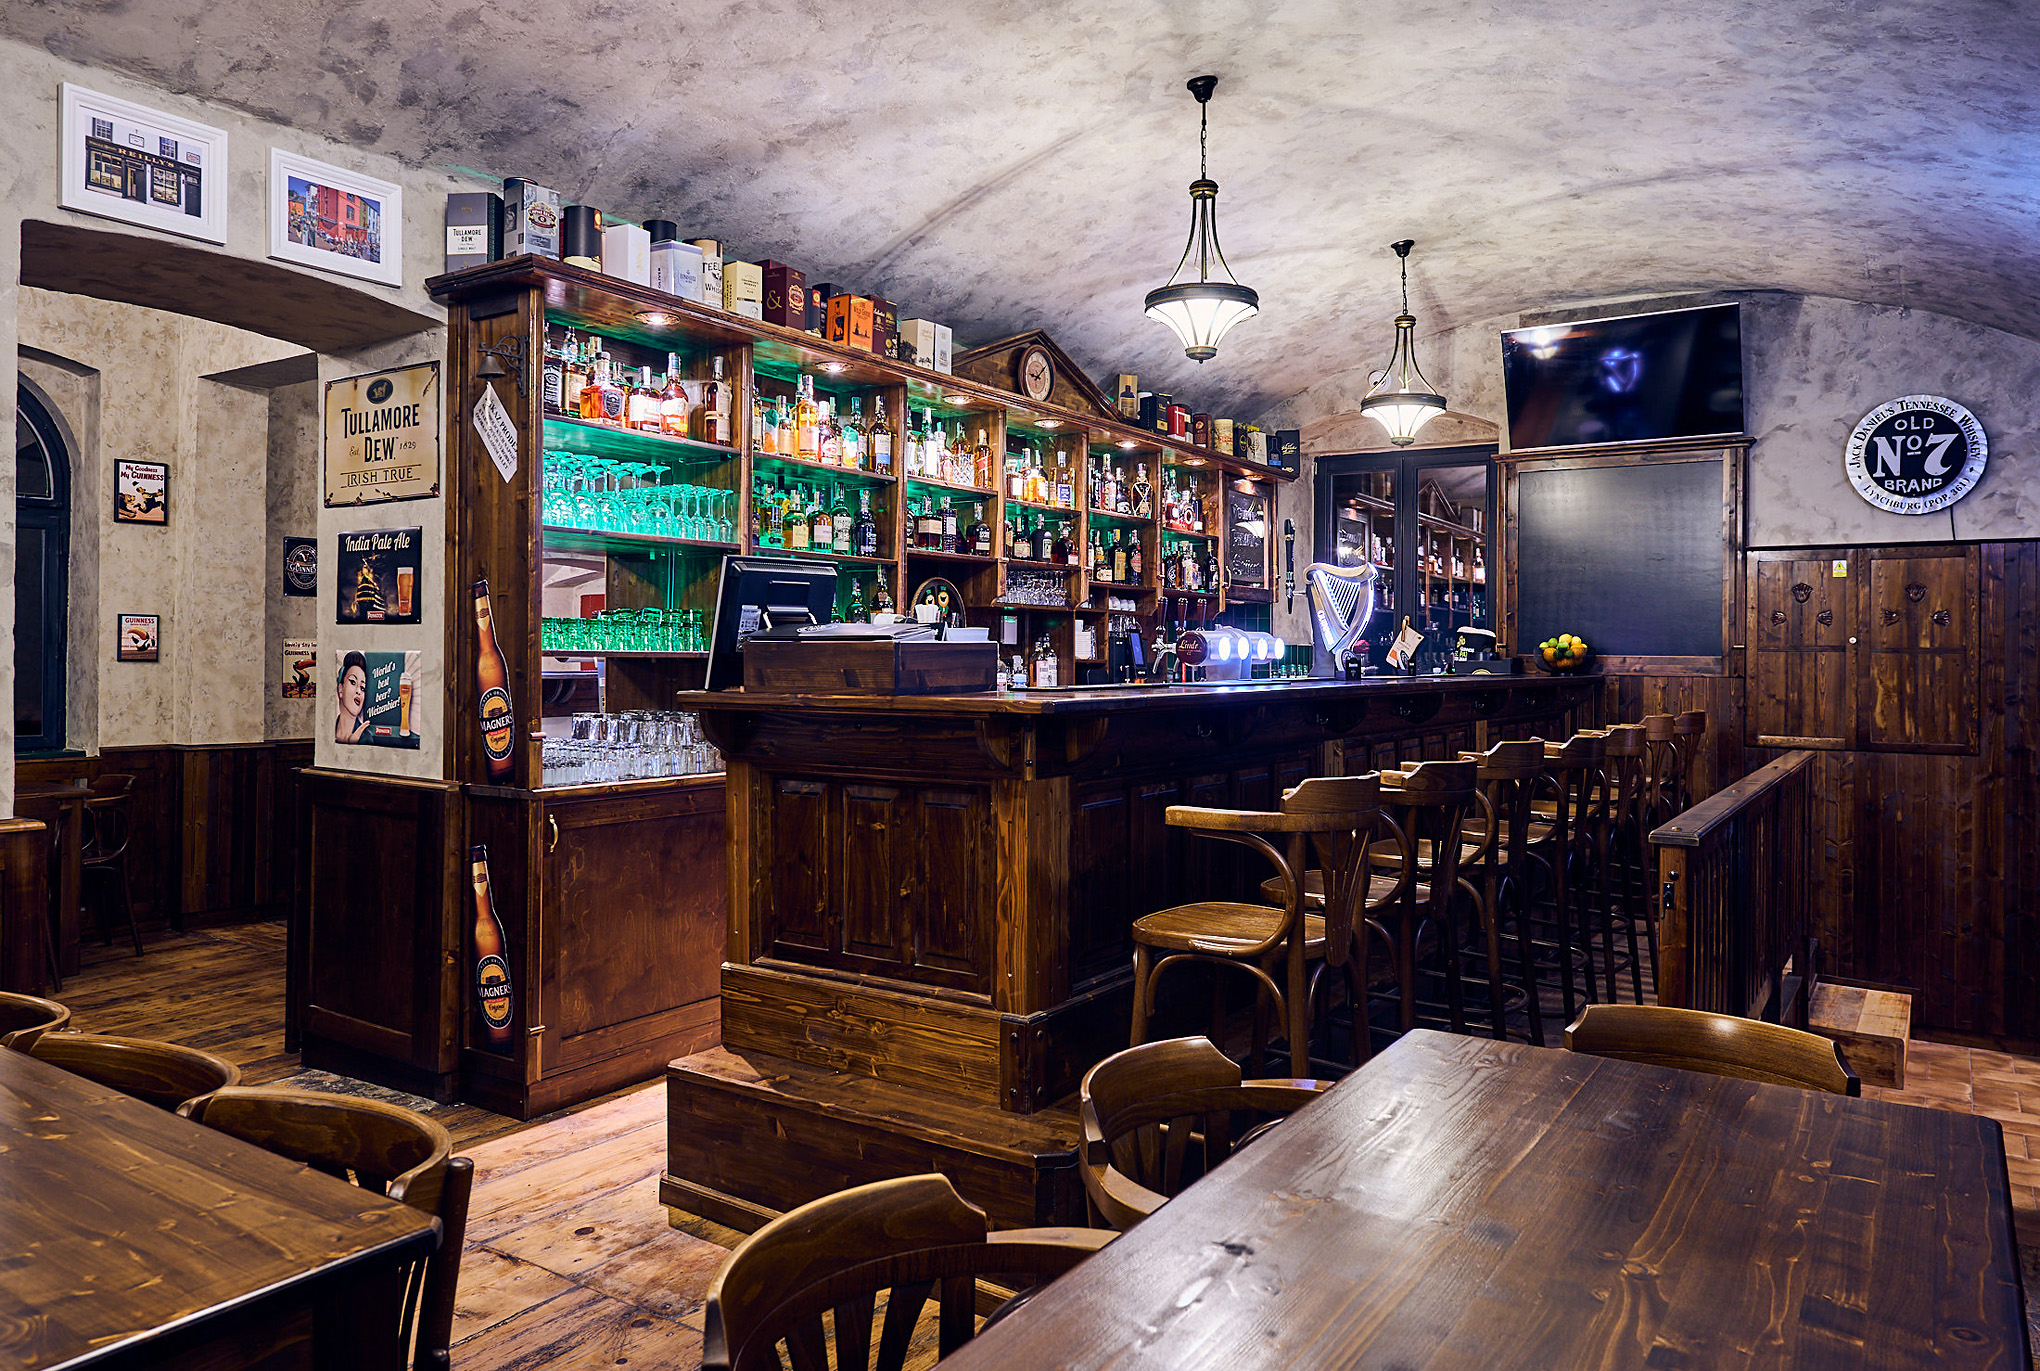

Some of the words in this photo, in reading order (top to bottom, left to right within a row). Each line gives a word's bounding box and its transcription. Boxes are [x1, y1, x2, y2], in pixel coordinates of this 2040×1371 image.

[118, 148, 175, 168] REILLY'S
[1896, 400, 1958, 419] TENNESSEE
[341, 403, 420, 438] TULLAMORE
[1854, 406, 1895, 442] DANIEL'S
[1894, 416, 1935, 431] OLD
[399, 441, 416, 450] 1829
[1958, 413, 1981, 460] WHISKEY
[1849, 444, 1862, 469] JACK
[121, 471, 129, 480] My
[131, 471, 164, 481] GUINNESS
[125, 464, 134, 472] My
[347, 472, 377, 486] IRISH
[383, 467, 413, 481] TRUE
[1884, 478, 1943, 494] BRAND
[1863, 484, 1921, 510] LYNCHBURG
[345, 535, 370, 552] India
[371, 533, 392, 551] Pale
[393, 531, 411, 551] Ale
[290, 563, 317, 573] GUINNES
[372, 661, 396, 679] World's
[377, 677, 390, 690] best
[375, 688, 392, 703] beer?
